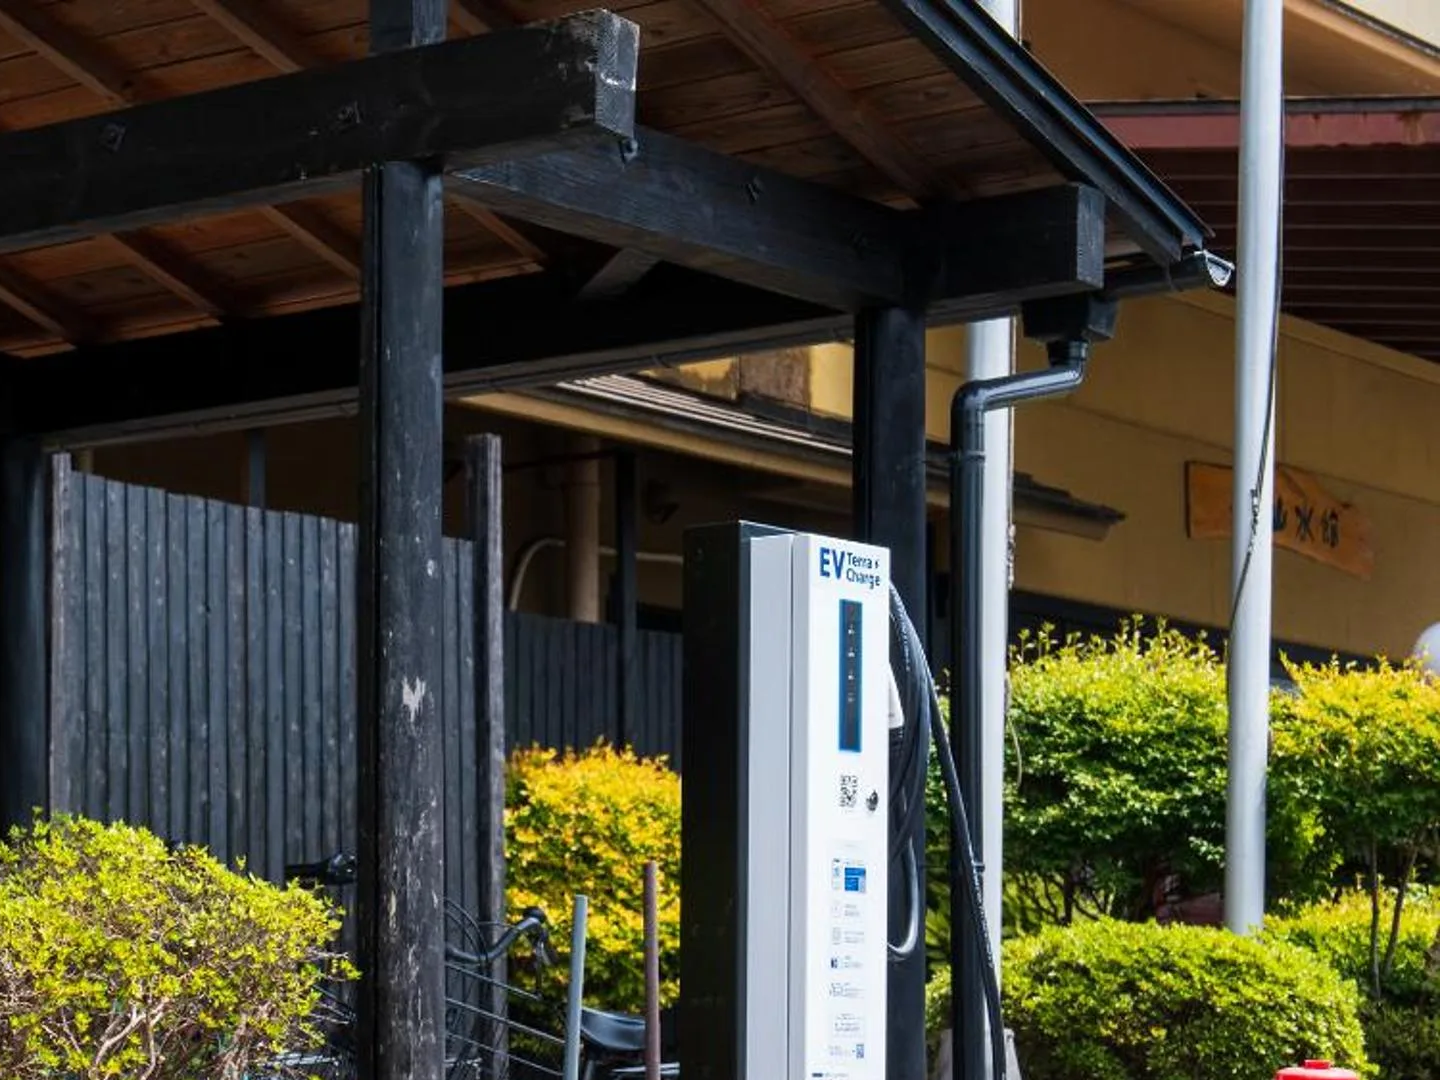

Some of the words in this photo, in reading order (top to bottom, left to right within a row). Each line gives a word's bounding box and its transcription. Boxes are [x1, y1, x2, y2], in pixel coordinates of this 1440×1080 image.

[820, 547, 845, 580] EV
[847, 552, 873, 569] Terra
[846, 568, 880, 590] Charge
